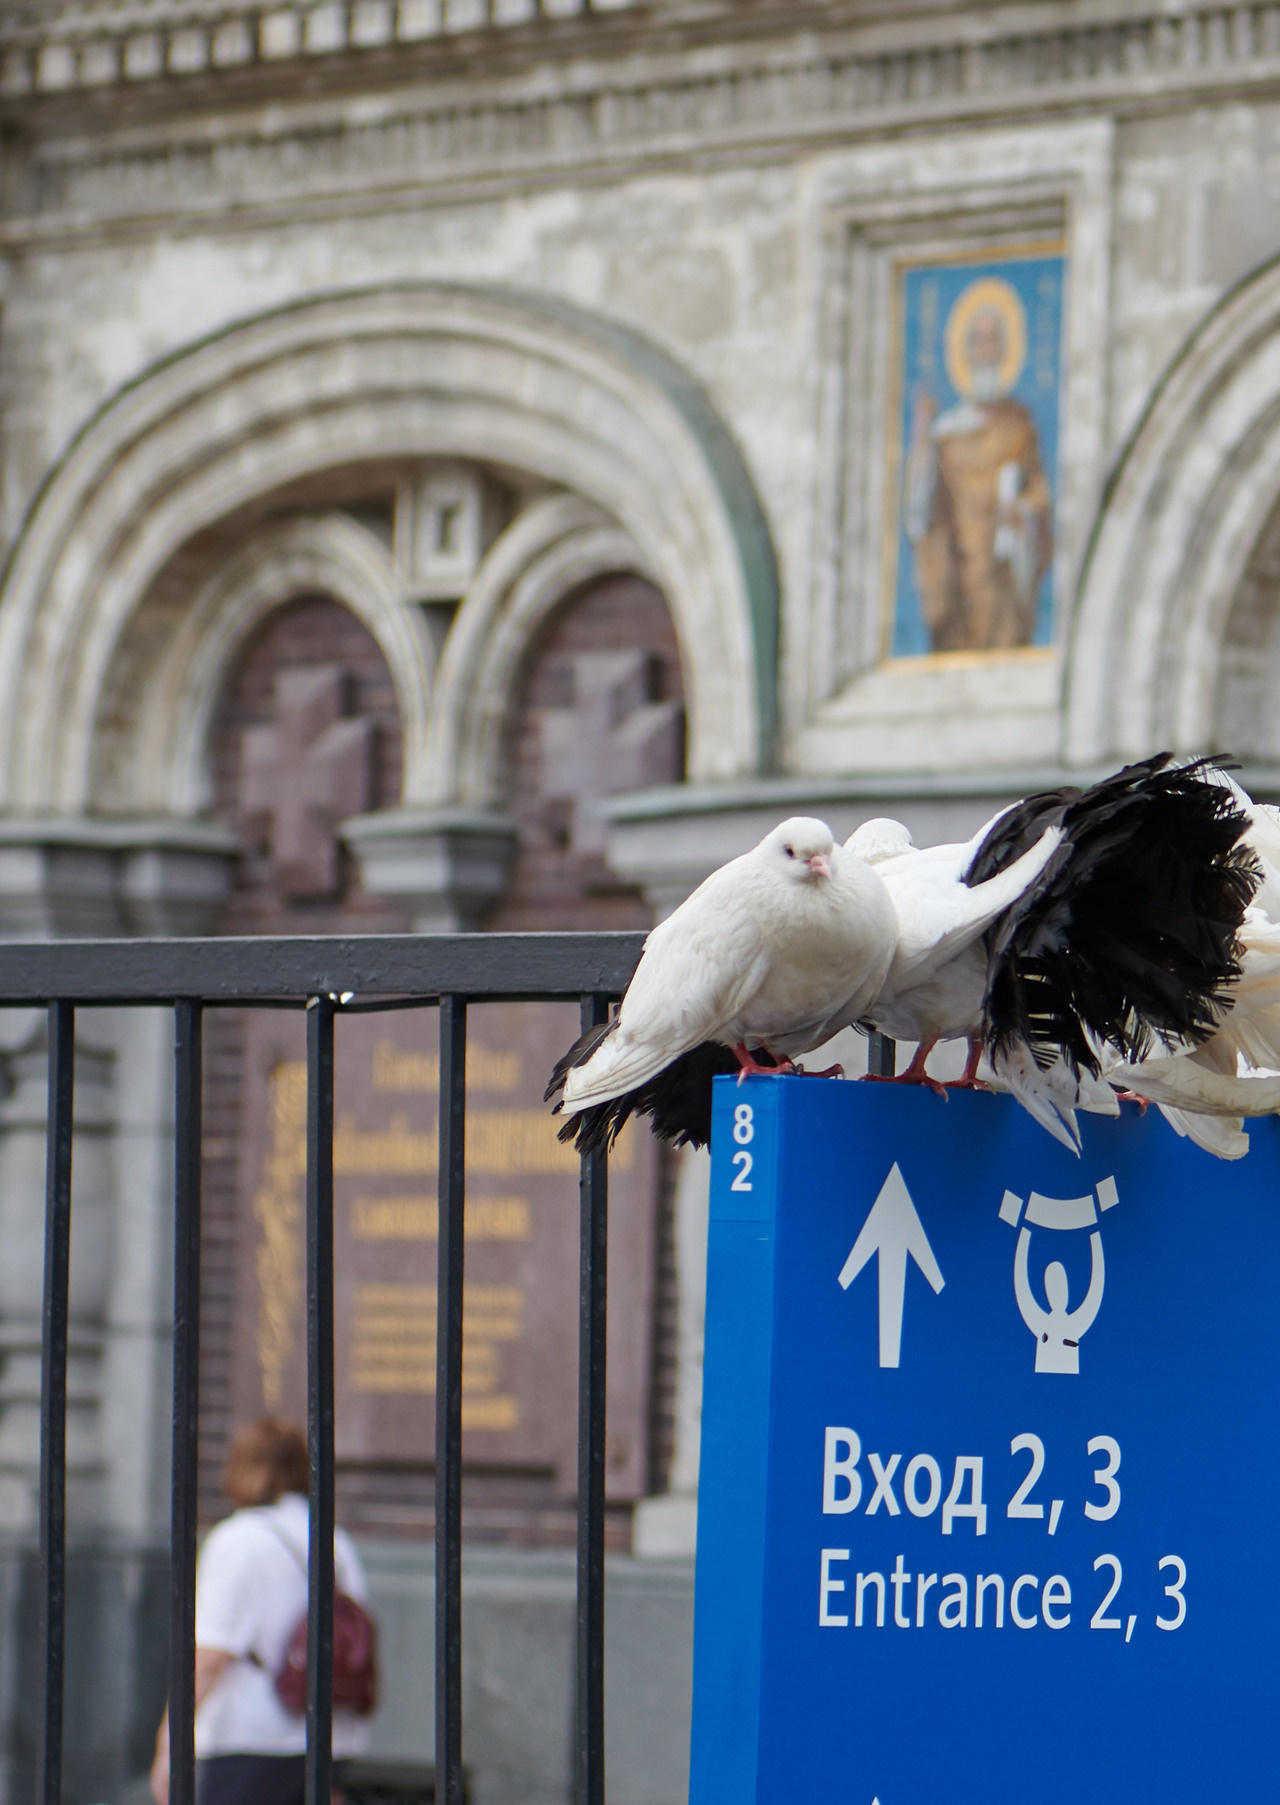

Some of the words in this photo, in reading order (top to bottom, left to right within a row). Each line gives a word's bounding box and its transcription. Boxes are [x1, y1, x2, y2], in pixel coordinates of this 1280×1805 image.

[822, 1426, 987, 1536] Вход
[1006, 1432, 1064, 1536] 2,
[1083, 1435, 1122, 1522] 3
[818, 1548, 1073, 1630] Entrance
[1090, 1553, 1137, 1643] 2,
[1155, 1554, 1188, 1631] 3
